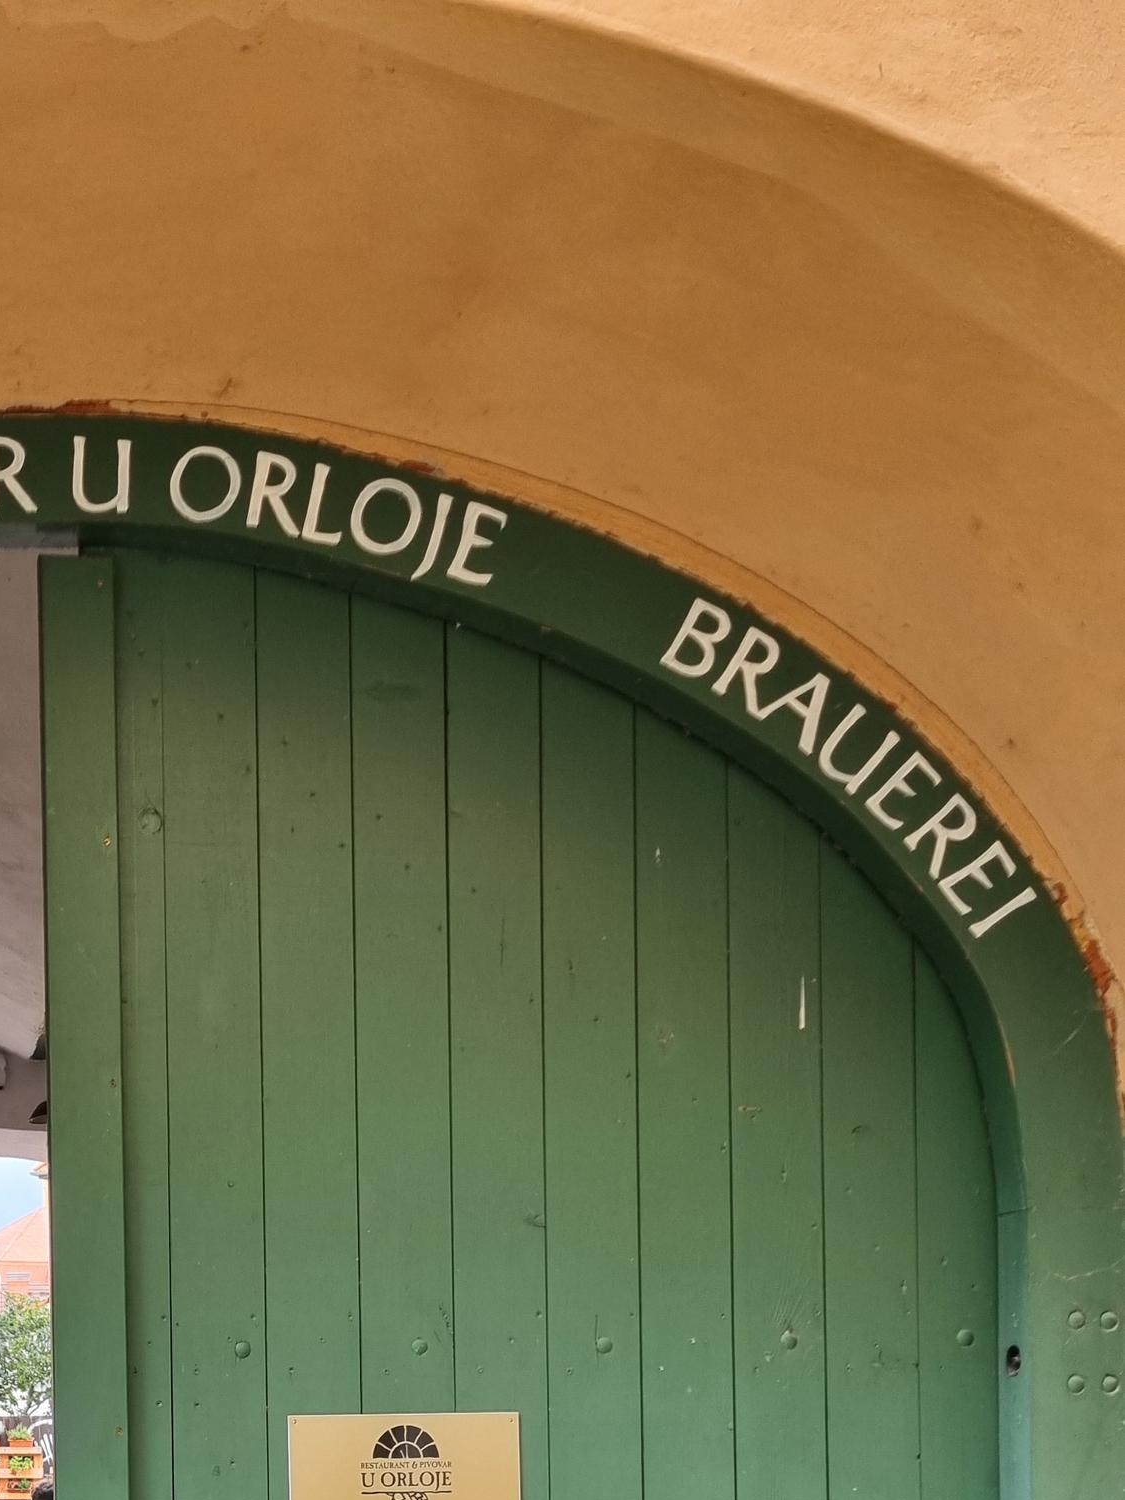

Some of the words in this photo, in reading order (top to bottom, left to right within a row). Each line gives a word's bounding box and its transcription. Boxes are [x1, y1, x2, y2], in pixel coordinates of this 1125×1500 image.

[71, 436, 132, 513] U
[169, 445, 508, 586] ORLOJE
[659, 597, 1037, 939] BRAUEREI
[361, 1472, 375, 1487] U
[380, 1471, 452, 1490] ORLOJE
[411, 1461, 418, 1469] &
